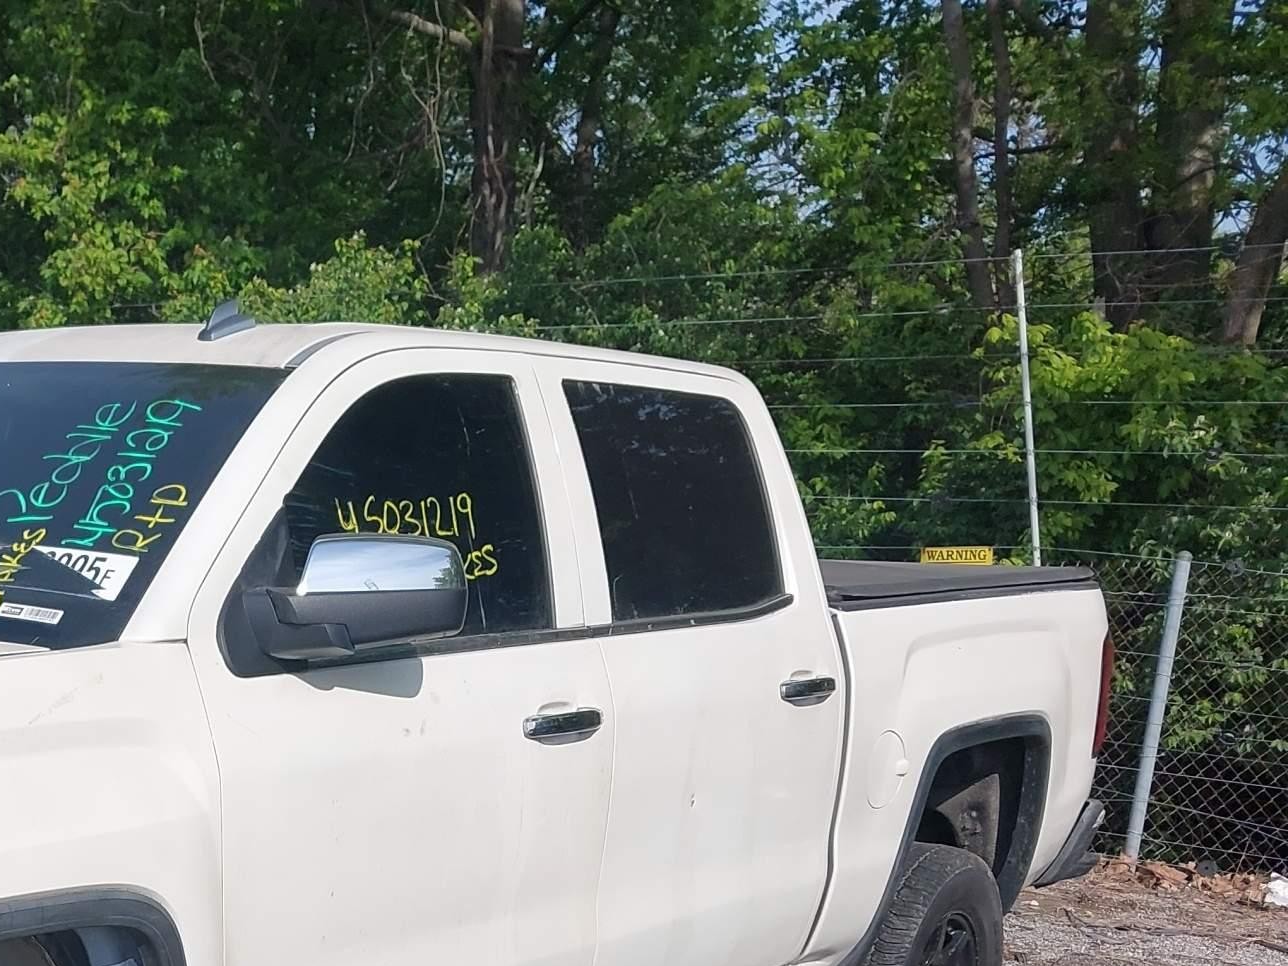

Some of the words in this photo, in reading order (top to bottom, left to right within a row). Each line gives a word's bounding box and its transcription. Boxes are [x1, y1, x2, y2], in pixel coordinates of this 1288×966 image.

[62, 399, 202, 546] 45031219
[335, 493, 475, 540] 45031219
[926, 549, 986, 561] WARNING
